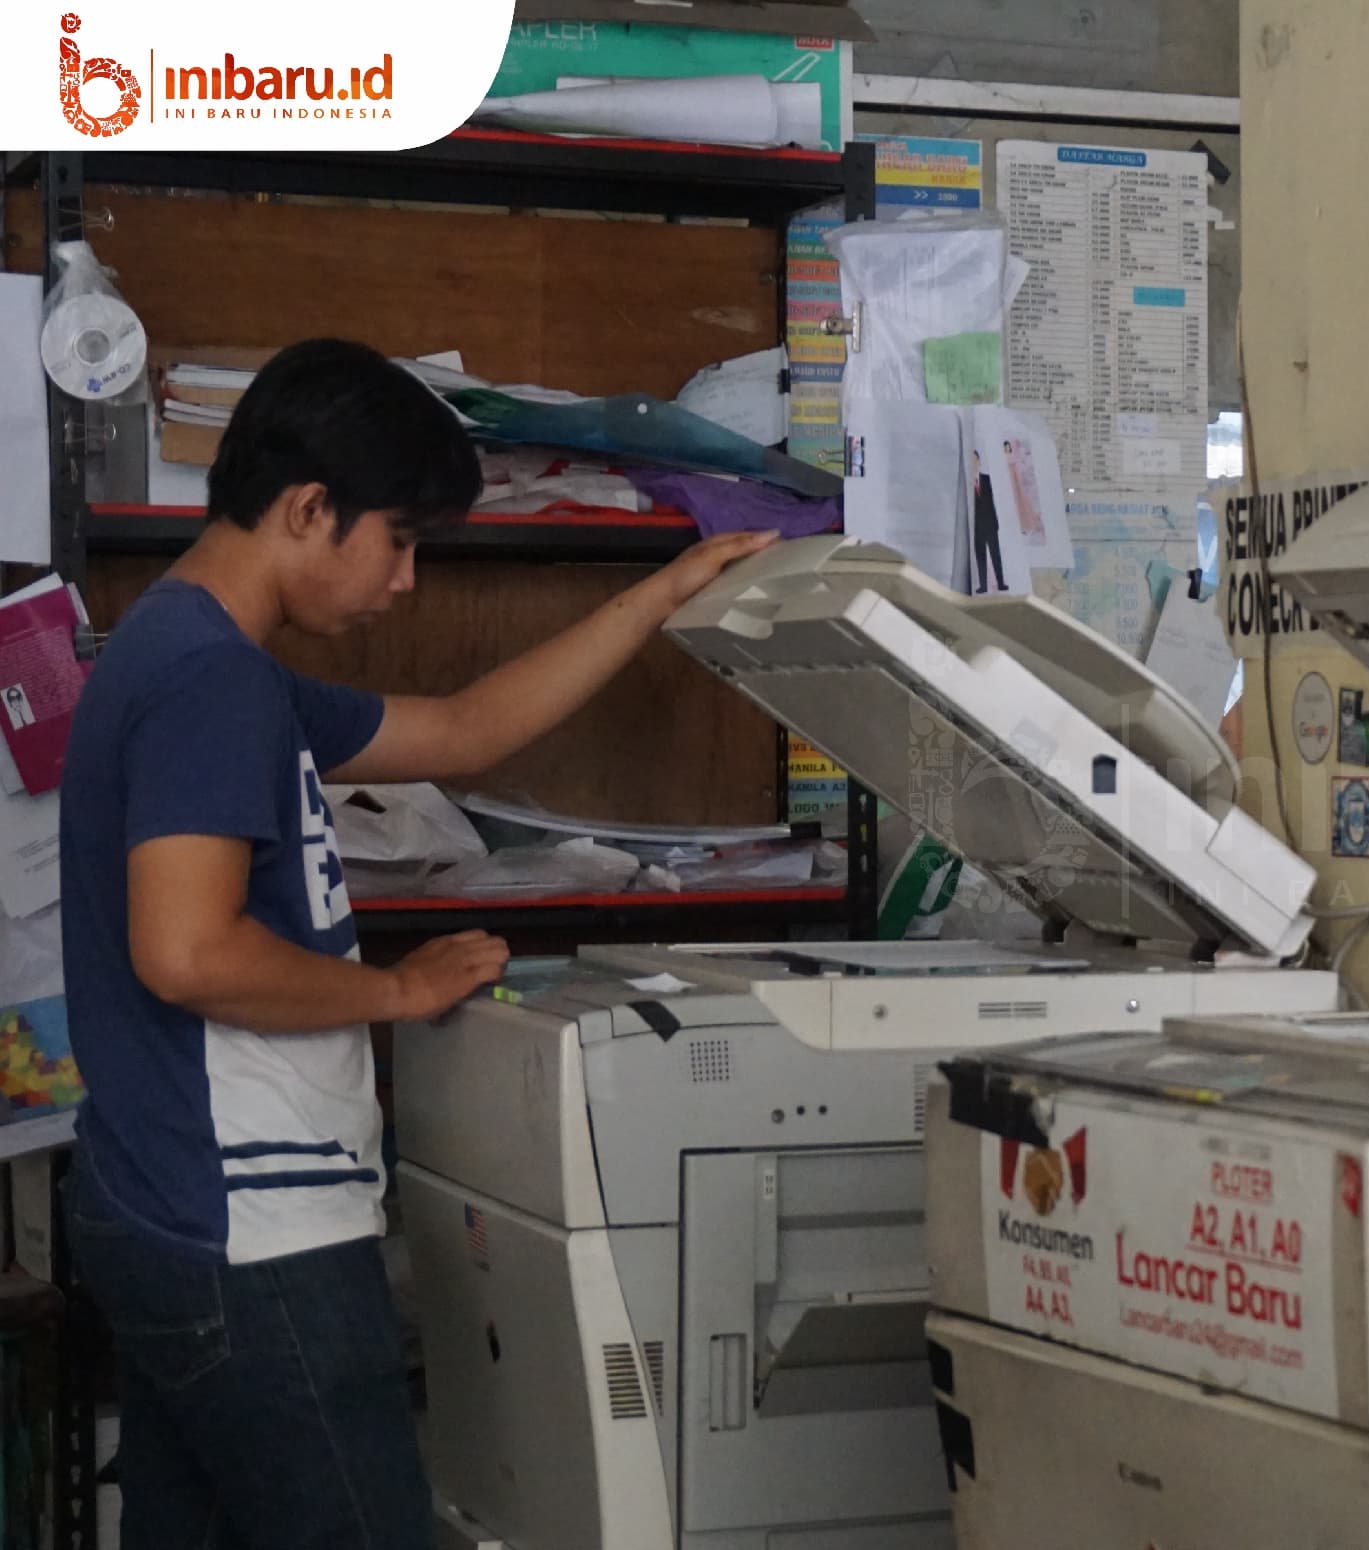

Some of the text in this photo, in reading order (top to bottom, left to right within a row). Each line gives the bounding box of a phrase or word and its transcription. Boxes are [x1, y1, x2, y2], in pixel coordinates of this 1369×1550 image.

[1226, 492, 1287, 560] SEMUA
[1210, 1160, 1273, 1201] PLOTER
[998, 1208, 1095, 1261] Konsumen
[1115, 1230, 1302, 1331] Lancar Baru
